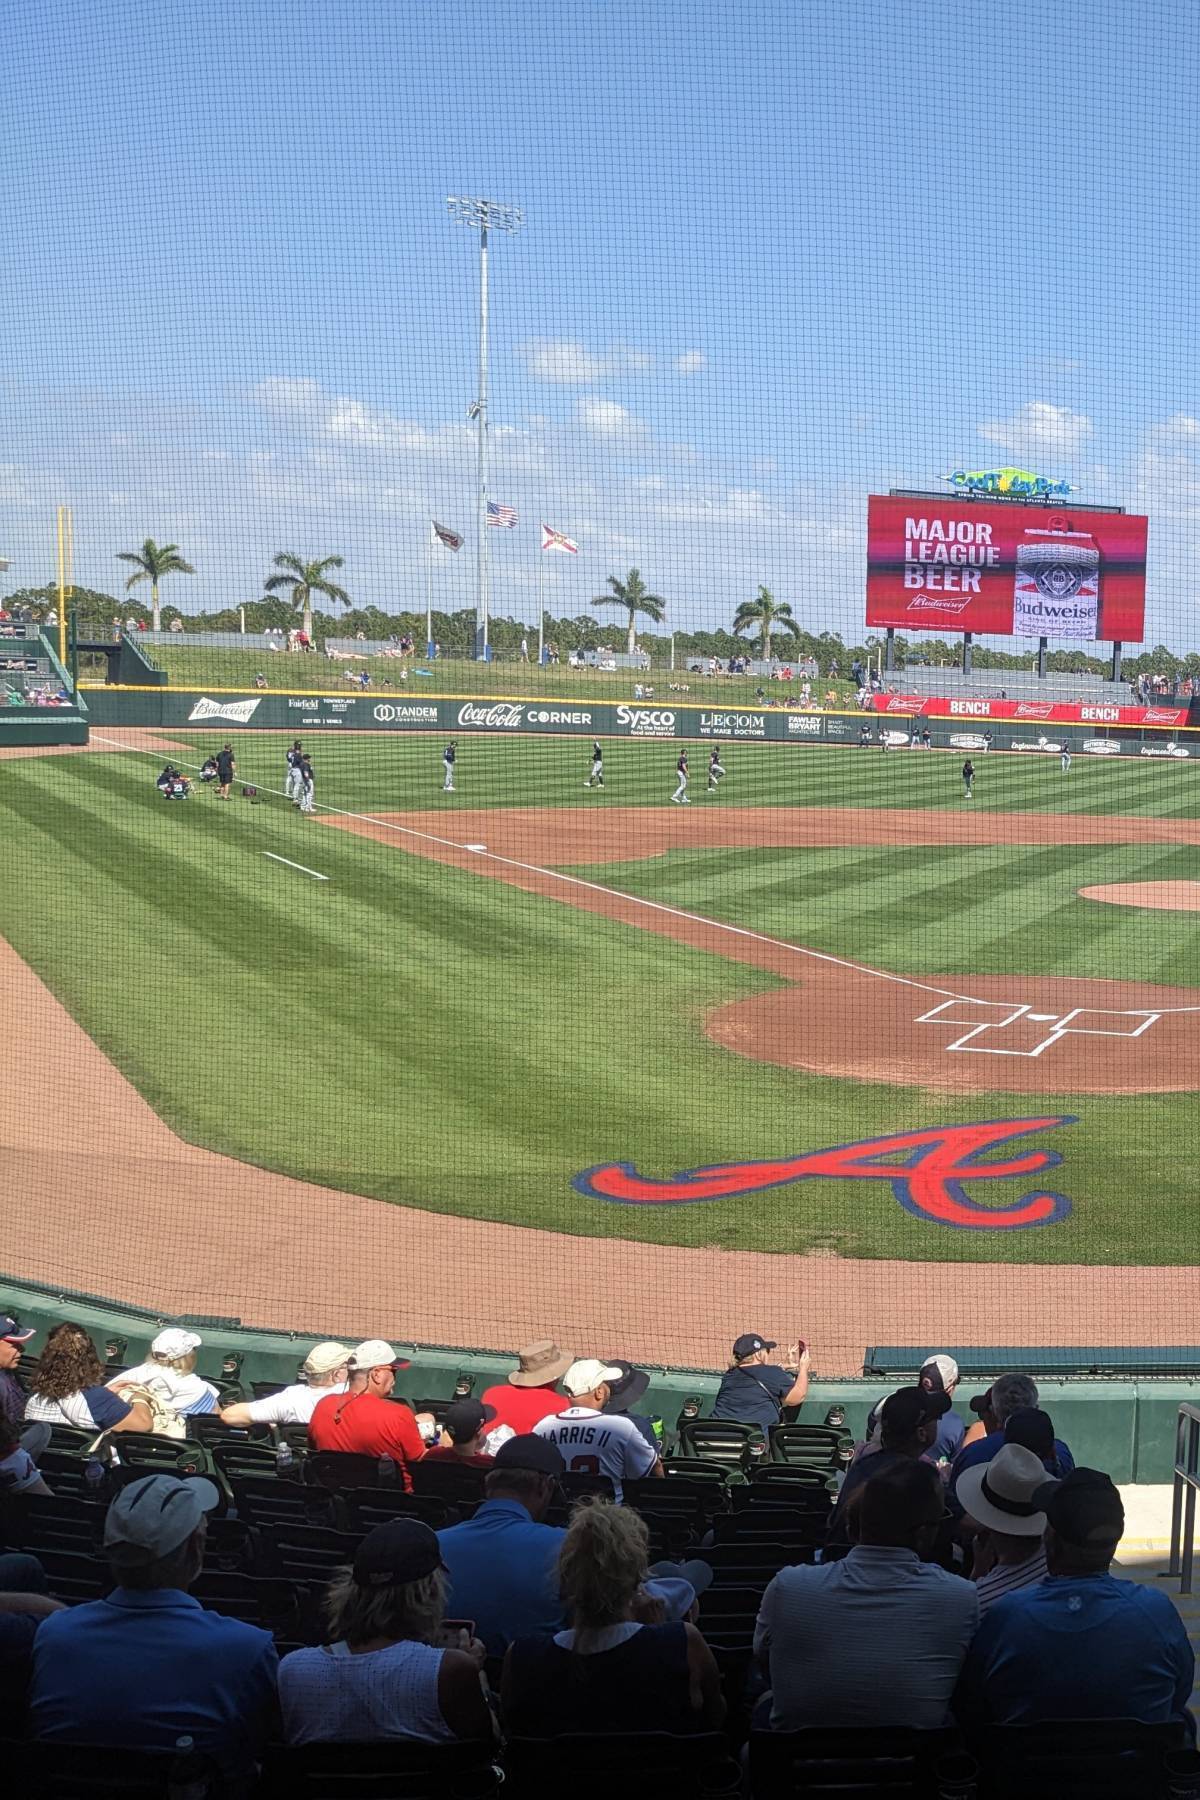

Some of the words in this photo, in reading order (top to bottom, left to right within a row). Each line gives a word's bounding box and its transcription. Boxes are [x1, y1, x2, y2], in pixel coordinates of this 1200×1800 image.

[905, 517, 992, 544] MAJOR
[905, 541, 1000, 568] LEAGUE
[904, 563, 982, 592] BEER
[914, 598, 964, 610] Budweiser
[194, 702, 253, 716] Budweiser
[288, 698, 319, 708] Fairfield
[950, 700, 990, 715] BENCH
[396, 706, 438, 717] TANDEM
[458, 702, 526, 728] Coca-Cola
[527, 710, 592, 725] CORNER
[616, 705, 675, 728] Sysco
[1081, 707, 1119, 720] BENCH
[788, 722, 821, 730] BRYANT
[1010, 742, 1040, 750] Englewood
[1140, 746, 1170, 756] Englewood
